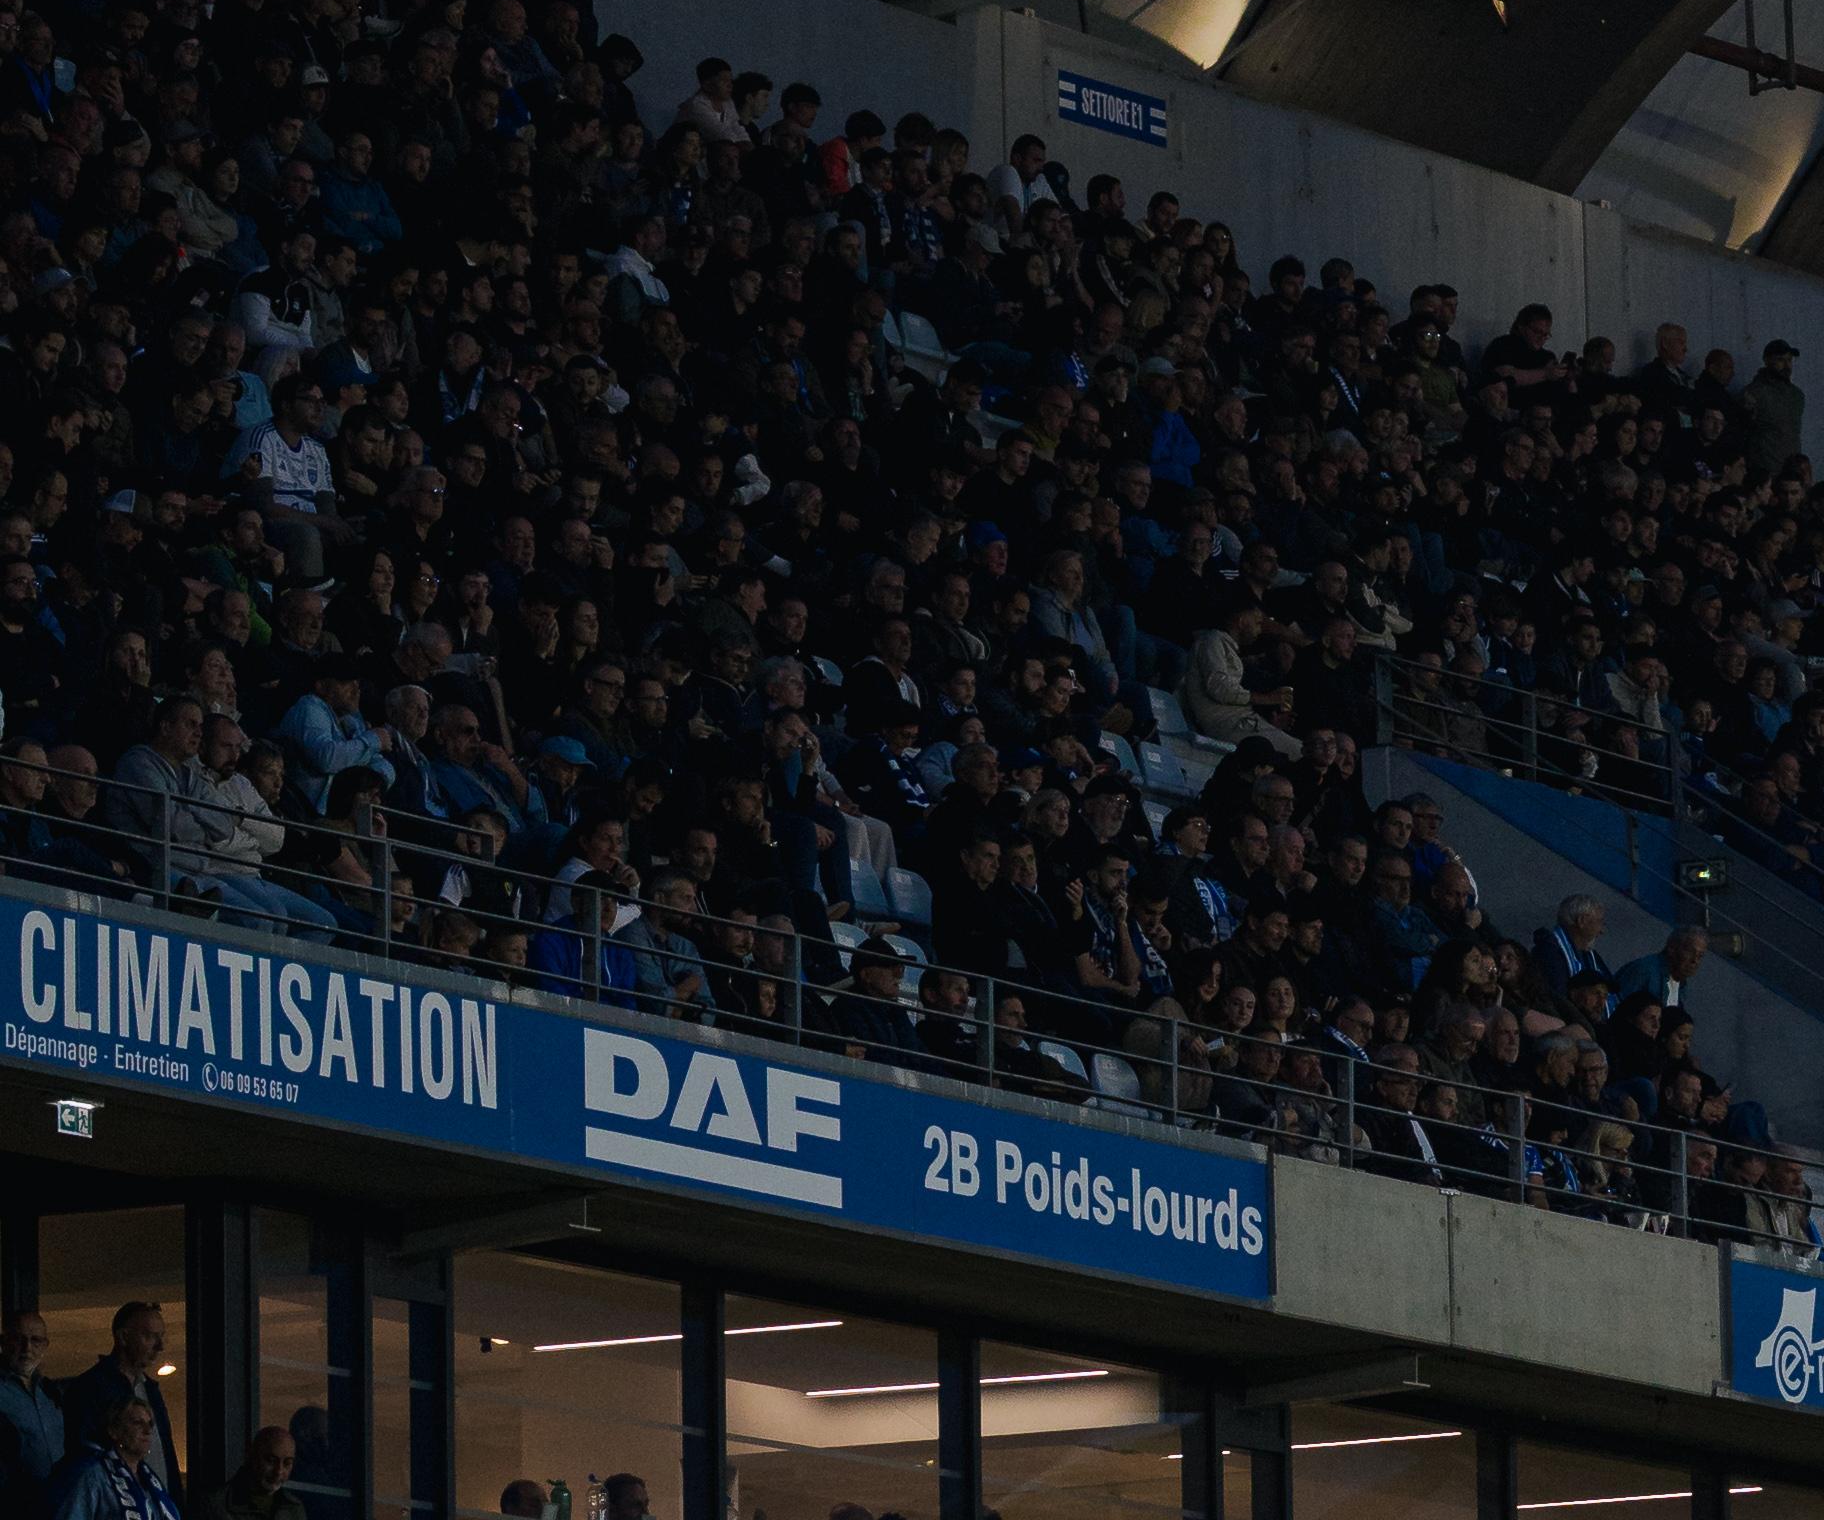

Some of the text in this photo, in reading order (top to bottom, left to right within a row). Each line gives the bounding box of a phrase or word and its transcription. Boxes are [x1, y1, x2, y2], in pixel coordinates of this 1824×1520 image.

[1081, 87, 1143, 131] SETTORE E1
[5, 1022, 97, 1068] Dépannage
[114, 1043, 189, 1082] Entretien
[20, 910, 499, 1111] CLIMATISATION
[220, 1069, 299, 1104] 06 09 53 65 07
[583, 1027, 842, 1154] DAF
[924, 1125, 1265, 1256] 2B Poids-lourds
